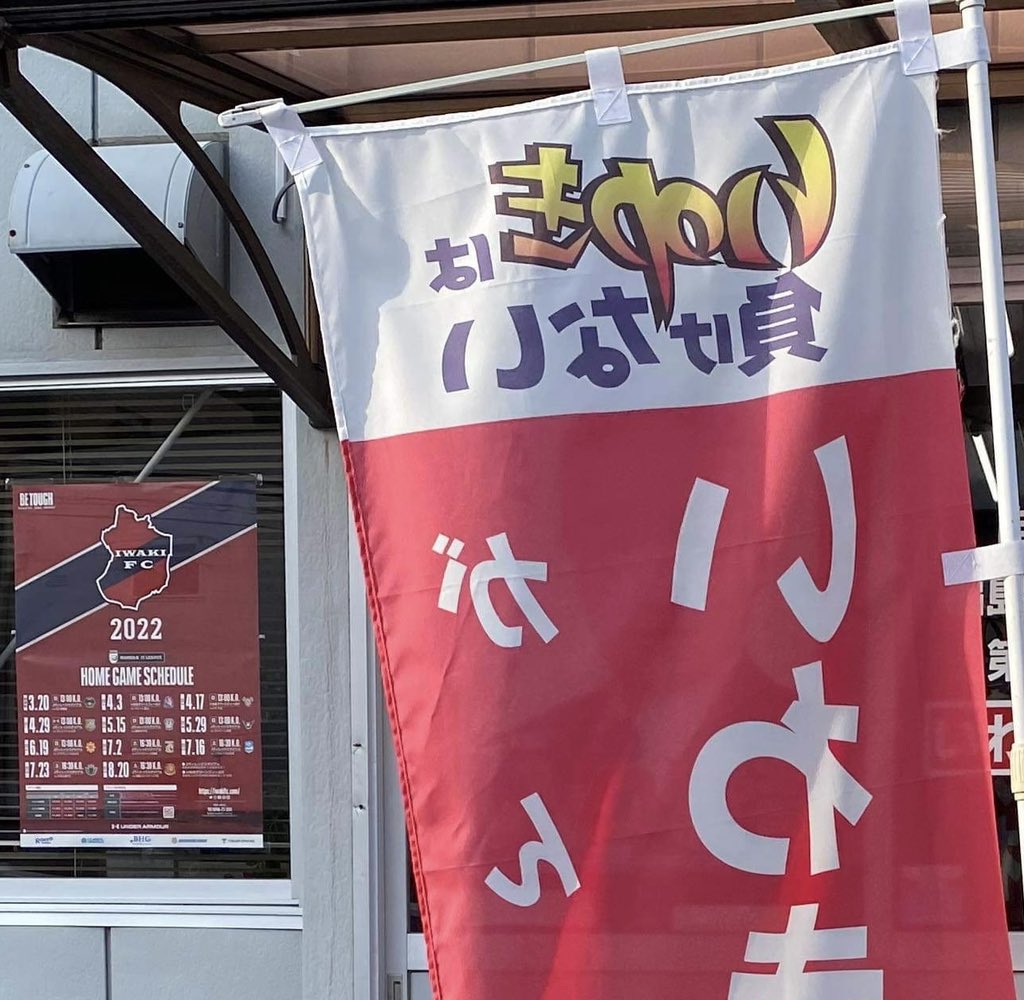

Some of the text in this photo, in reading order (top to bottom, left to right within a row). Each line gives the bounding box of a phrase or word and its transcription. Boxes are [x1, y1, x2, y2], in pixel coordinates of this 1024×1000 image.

[114, 549, 167, 557] IWAKI
[110, 618, 162, 640] 2022
[80, 666, 194, 687] HOME GAME SCHEDULE
[28, 694, 50, 711] 3.20
[106, 694, 122, 710] 4.3
[186, 694, 204, 710] 4.17
[29, 717, 50, 733] 4.29
[107, 717, 126, 733] 5.15
[186, 716, 206, 732] 5.29
[30, 740, 48, 755] 6.19
[108, 740, 122, 755] 7.2
[187, 739, 205, 755] 7.16
[30, 762, 50, 778] 7.23
[108, 762, 129, 778] 8.20
